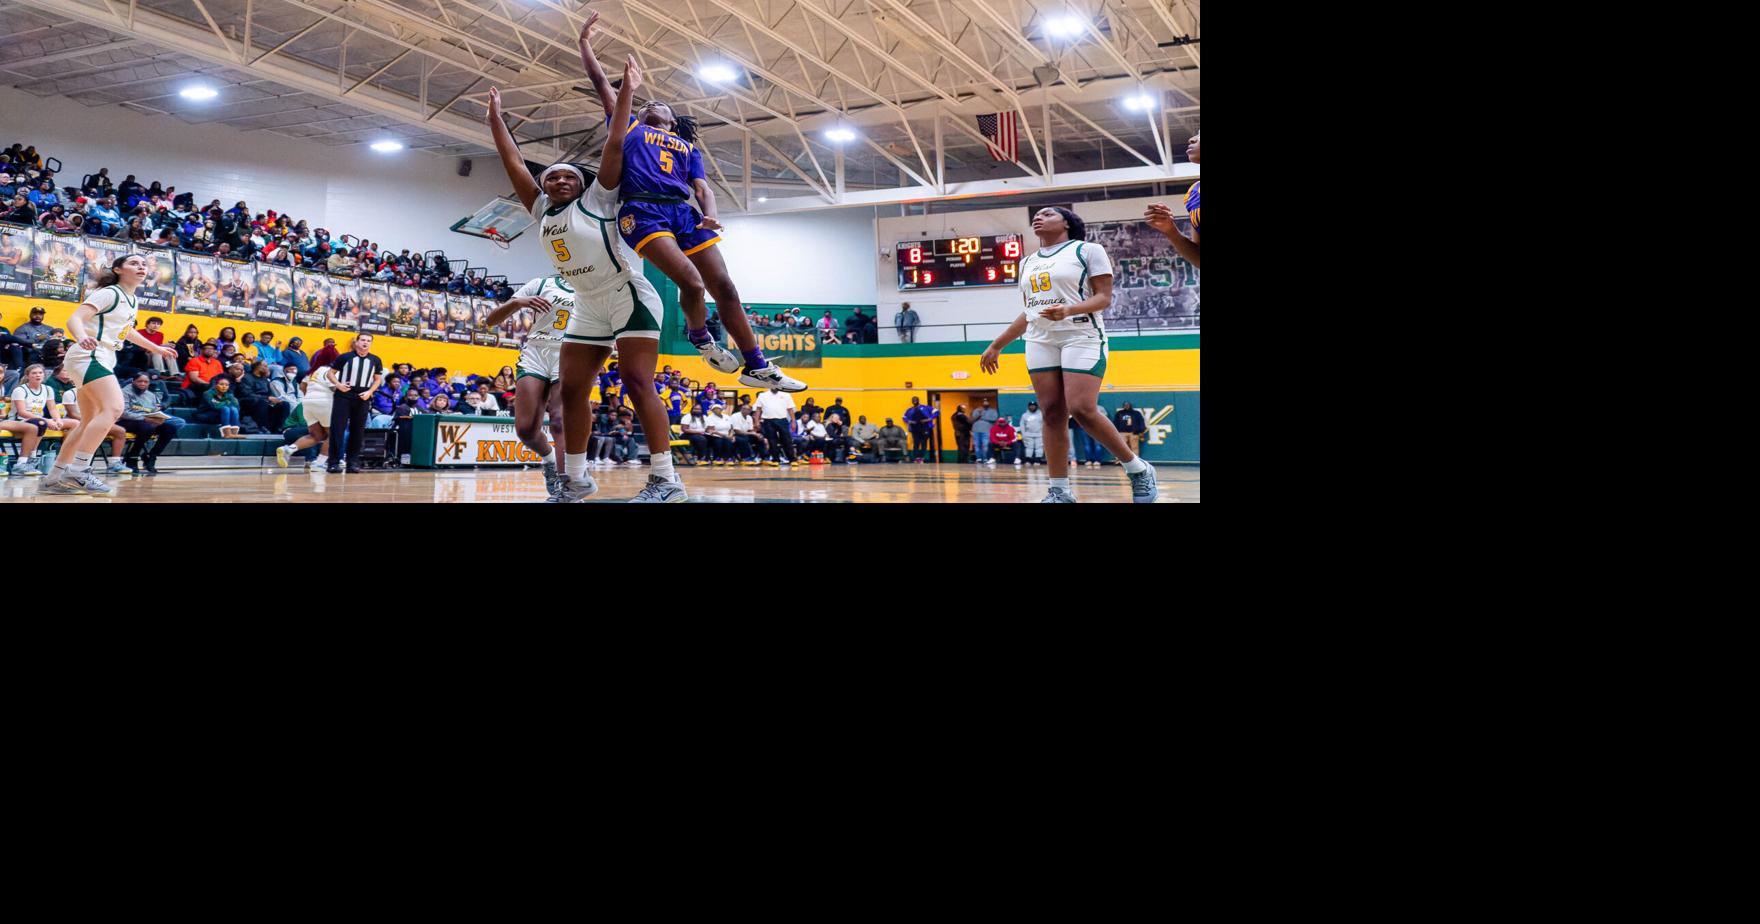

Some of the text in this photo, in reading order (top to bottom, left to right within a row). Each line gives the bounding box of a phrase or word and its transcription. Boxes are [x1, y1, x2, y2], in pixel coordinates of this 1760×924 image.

[660, 150, 673, 174] 5
[543, 224, 568, 237] West
[551, 239, 571, 262] 5
[951, 238, 979, 254] 1:20
[1004, 242, 1019, 257] 19
[910, 249, 921, 263] 8
[965, 254, 970, 263] 1
[913, 270, 918, 283] 1
[988, 270, 996, 280] 3
[1004, 264, 1015, 278] 4
[924, 273, 931, 284] 3
[1030, 272, 1052, 293] 13
[552, 295, 574, 307] Wes
[553, 309, 570, 330] 3
[727, 333, 816, 351] KIGHTS
[493, 424, 514, 433] WEST
[476, 440, 556, 462] KNIG
